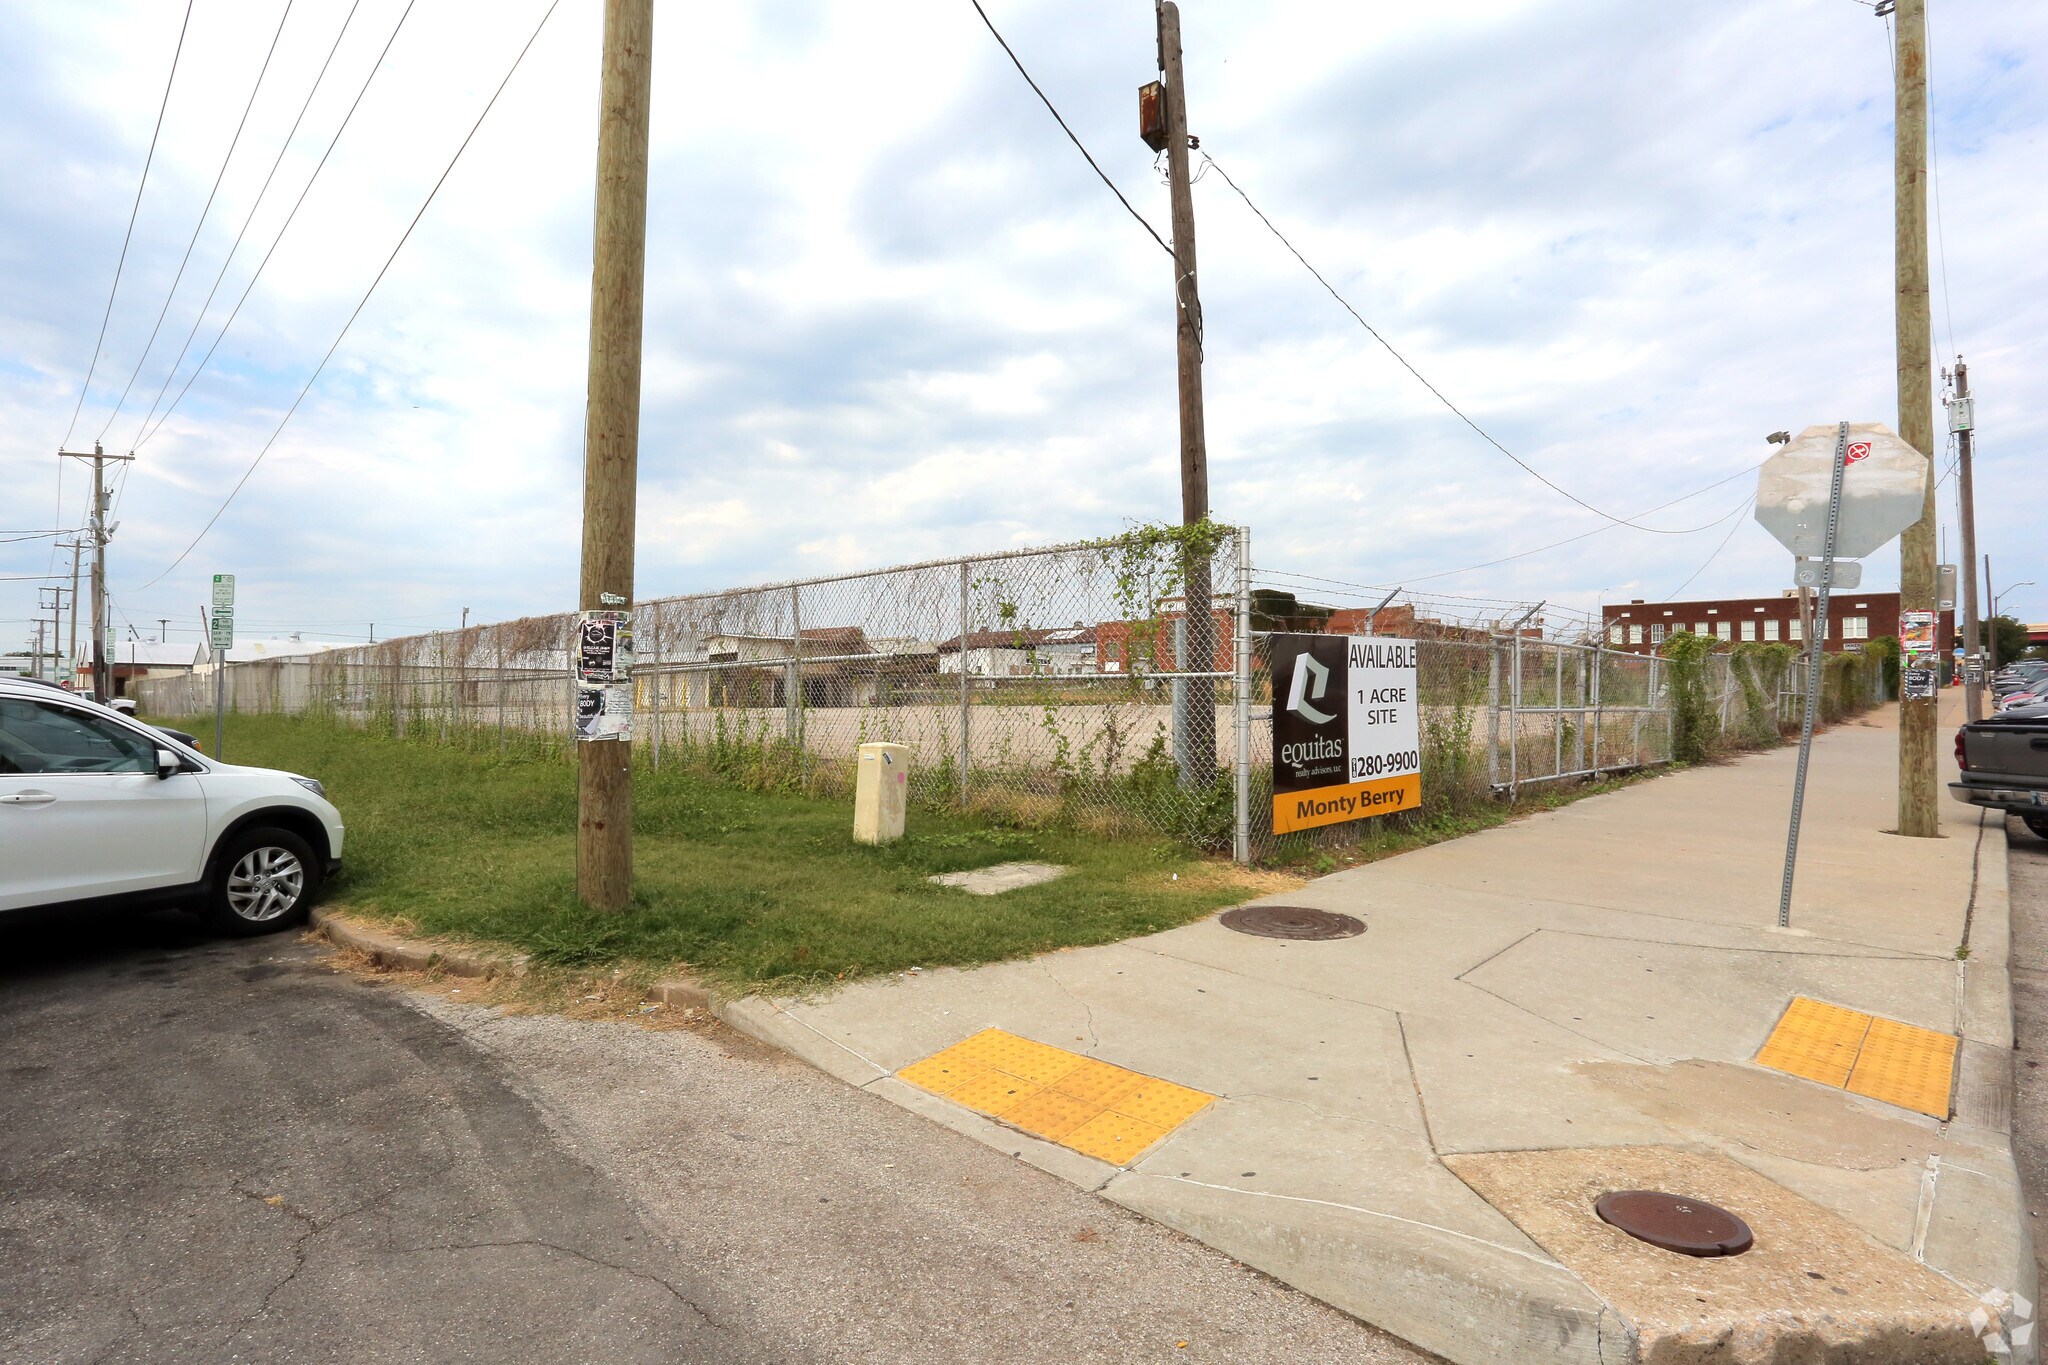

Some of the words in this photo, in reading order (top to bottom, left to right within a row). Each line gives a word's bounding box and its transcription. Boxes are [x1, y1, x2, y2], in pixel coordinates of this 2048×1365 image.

[213, 620, 218, 629] 2
[1349, 644, 1416, 668] AVAILABLE
[579, 699, 595, 707] BODY
[1357, 690, 1363, 704] 1
[1370, 688, 1407, 704] ACRE
[1367, 708, 1398, 725] SITE
[1281, 733, 1343, 769] equitas
[1357, 750, 1418, 777] 280-9900
[1295, 768, 1310, 779] realty
[1297, 796, 1357, 819] Monty
[1361, 788, 1405, 808] Berry
